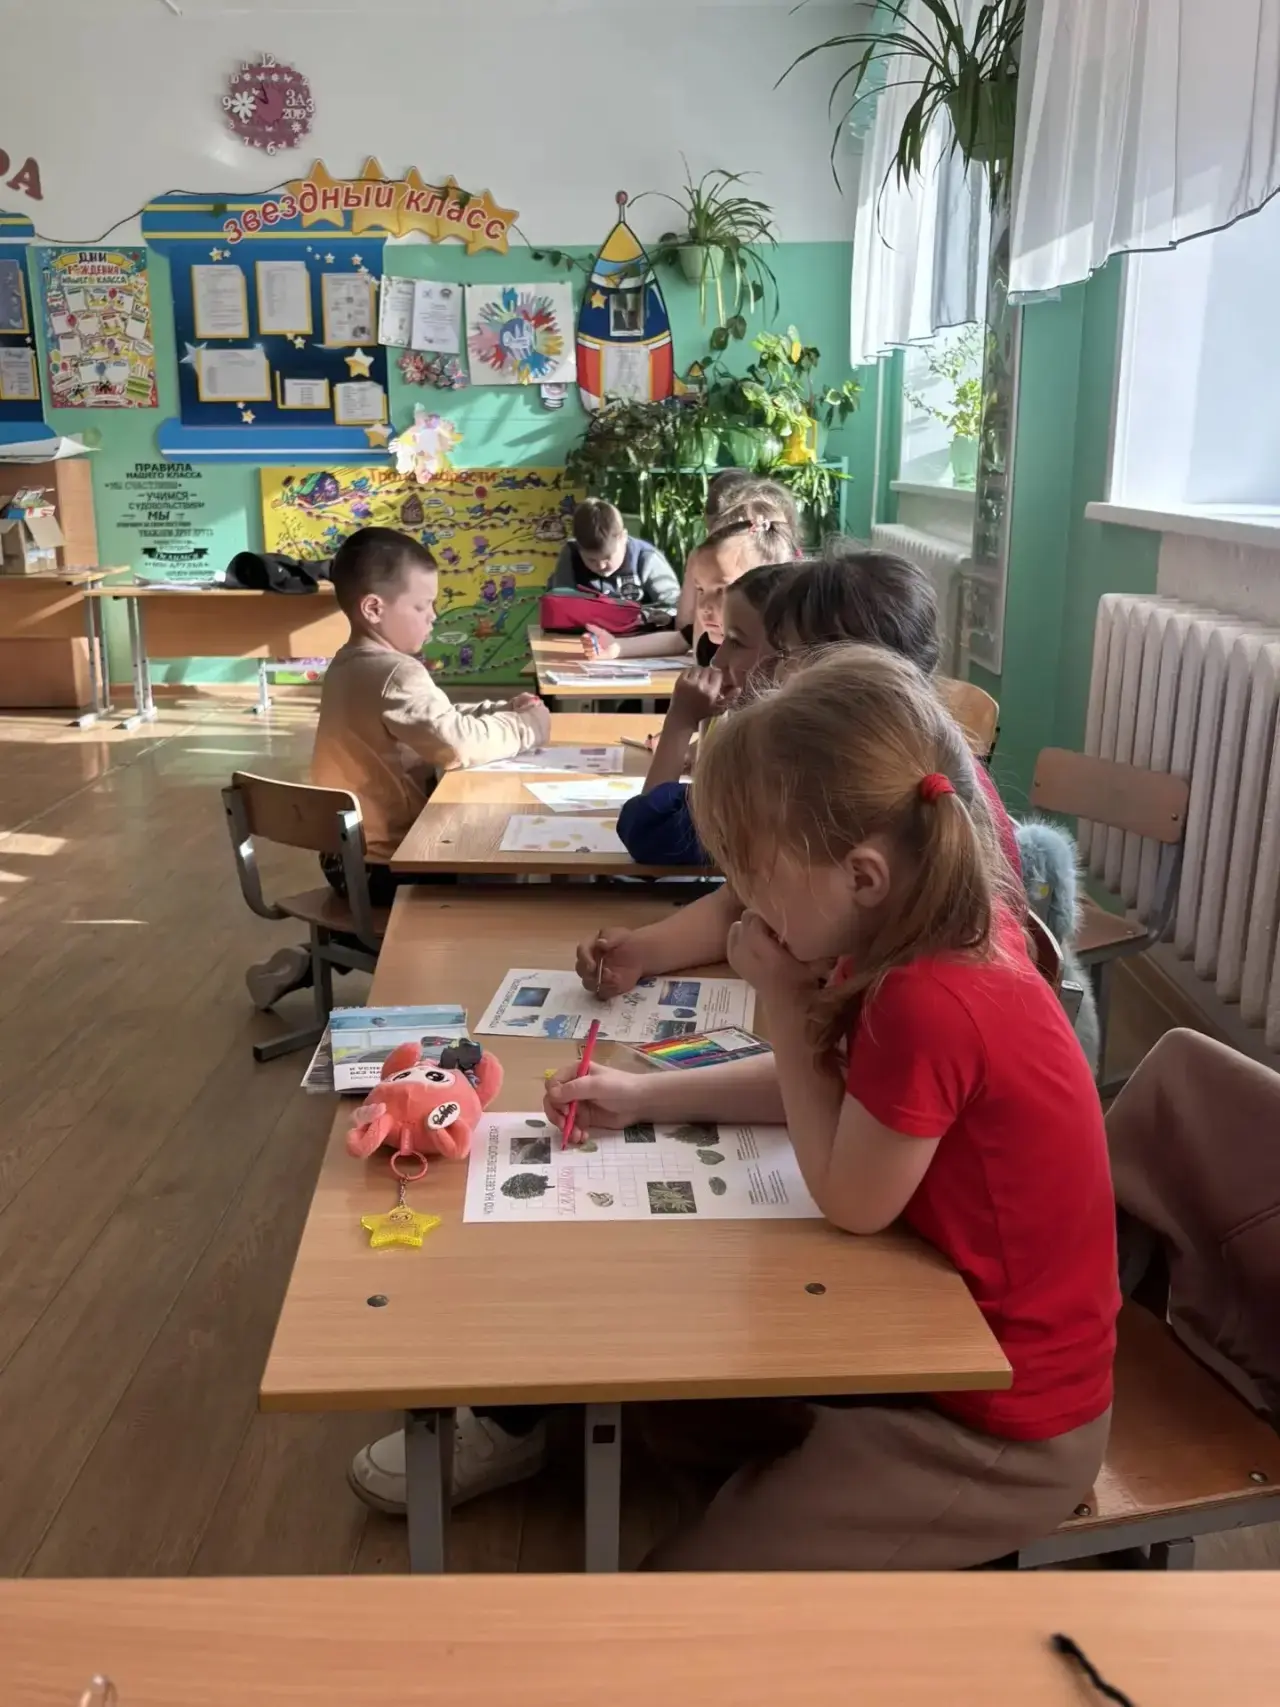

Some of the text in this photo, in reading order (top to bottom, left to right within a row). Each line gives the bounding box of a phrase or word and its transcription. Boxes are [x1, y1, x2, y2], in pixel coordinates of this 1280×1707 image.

[261, 53, 276, 68] 12
[222, 96, 232, 111] 9
[305, 98, 315, 113] 3
[282, 108, 306, 120] 2019
[267, 141, 276, 156] 6
[404, 187, 507, 240] класс
[79, 252, 107, 264] ДНИ
[135, 463, 193, 472] ПРАВИЛА
[146, 491, 189, 500] УЧИМСЯ
[147, 511, 170, 521] МЫ
[485, 1174, 496, 1191] СВЕТЕ
[485, 1191, 495, 1202] НА
